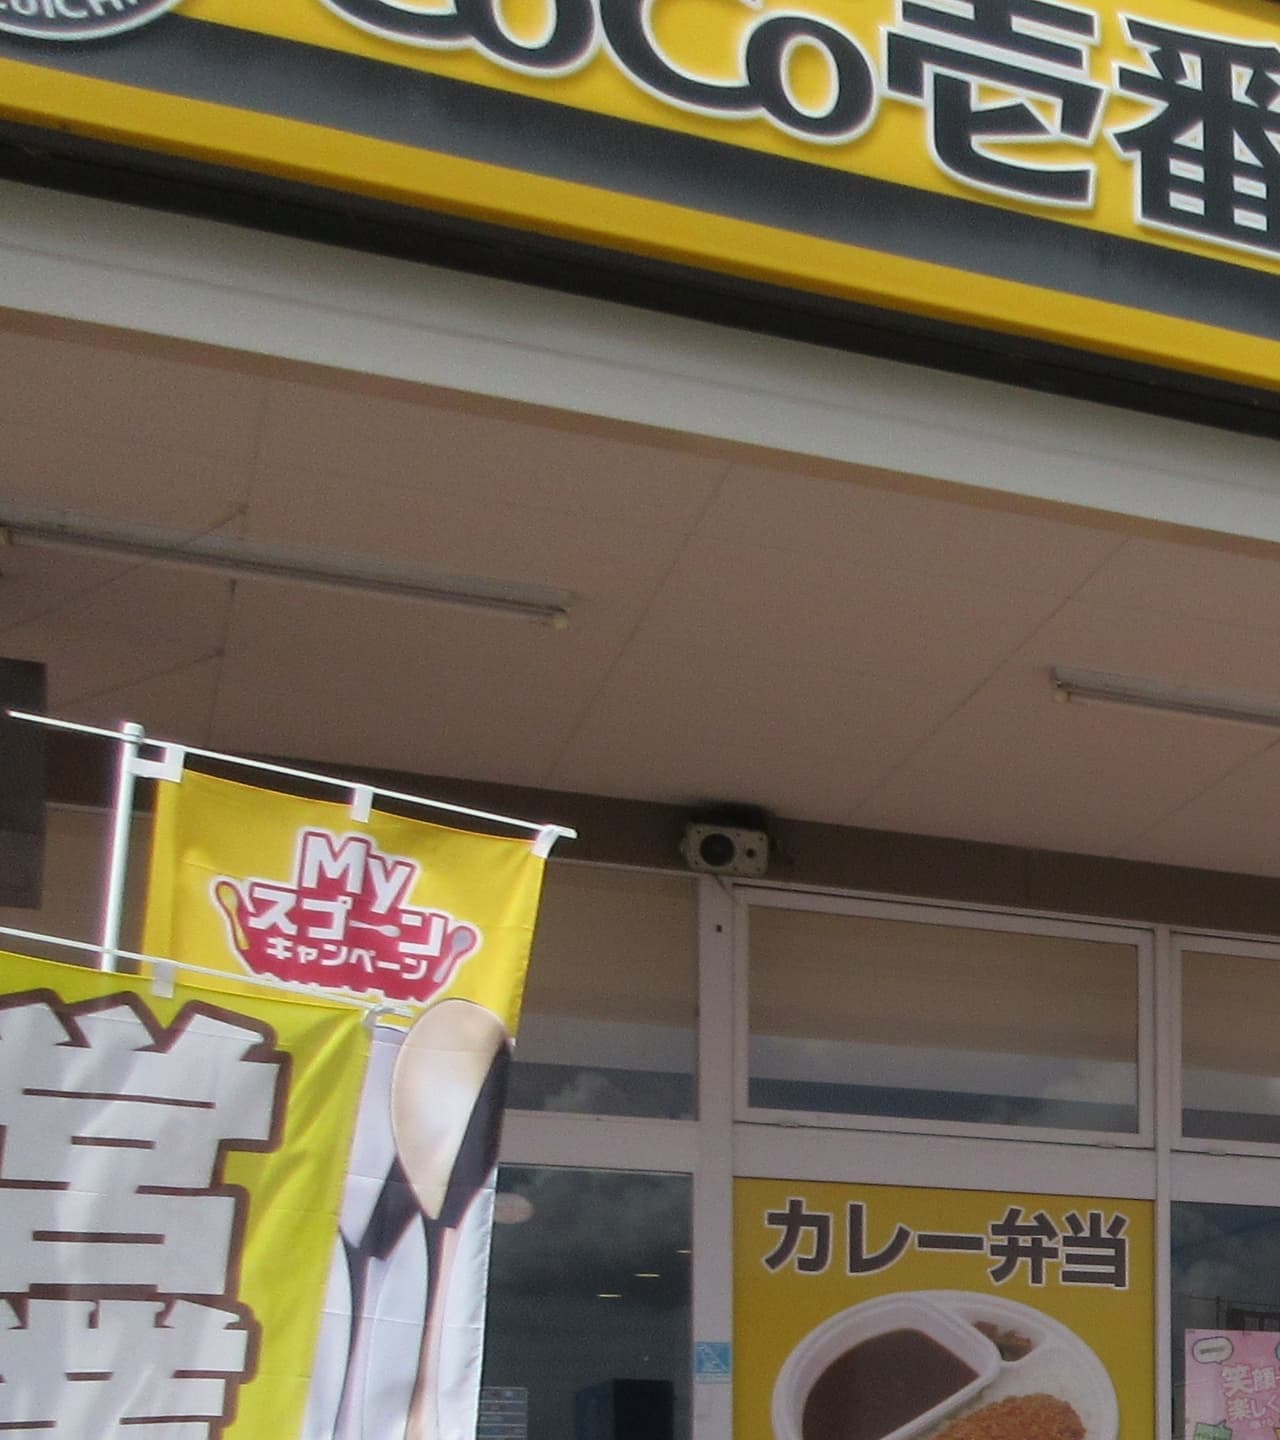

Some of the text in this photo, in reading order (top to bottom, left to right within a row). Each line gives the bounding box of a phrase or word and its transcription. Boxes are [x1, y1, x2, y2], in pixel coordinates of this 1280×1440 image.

[301, 834, 414, 915] My
[247, 886, 447, 957] スプーン
[266, 937, 428, 981] キャンペーン
[764, 1198, 1130, 1289] カレー弁当
